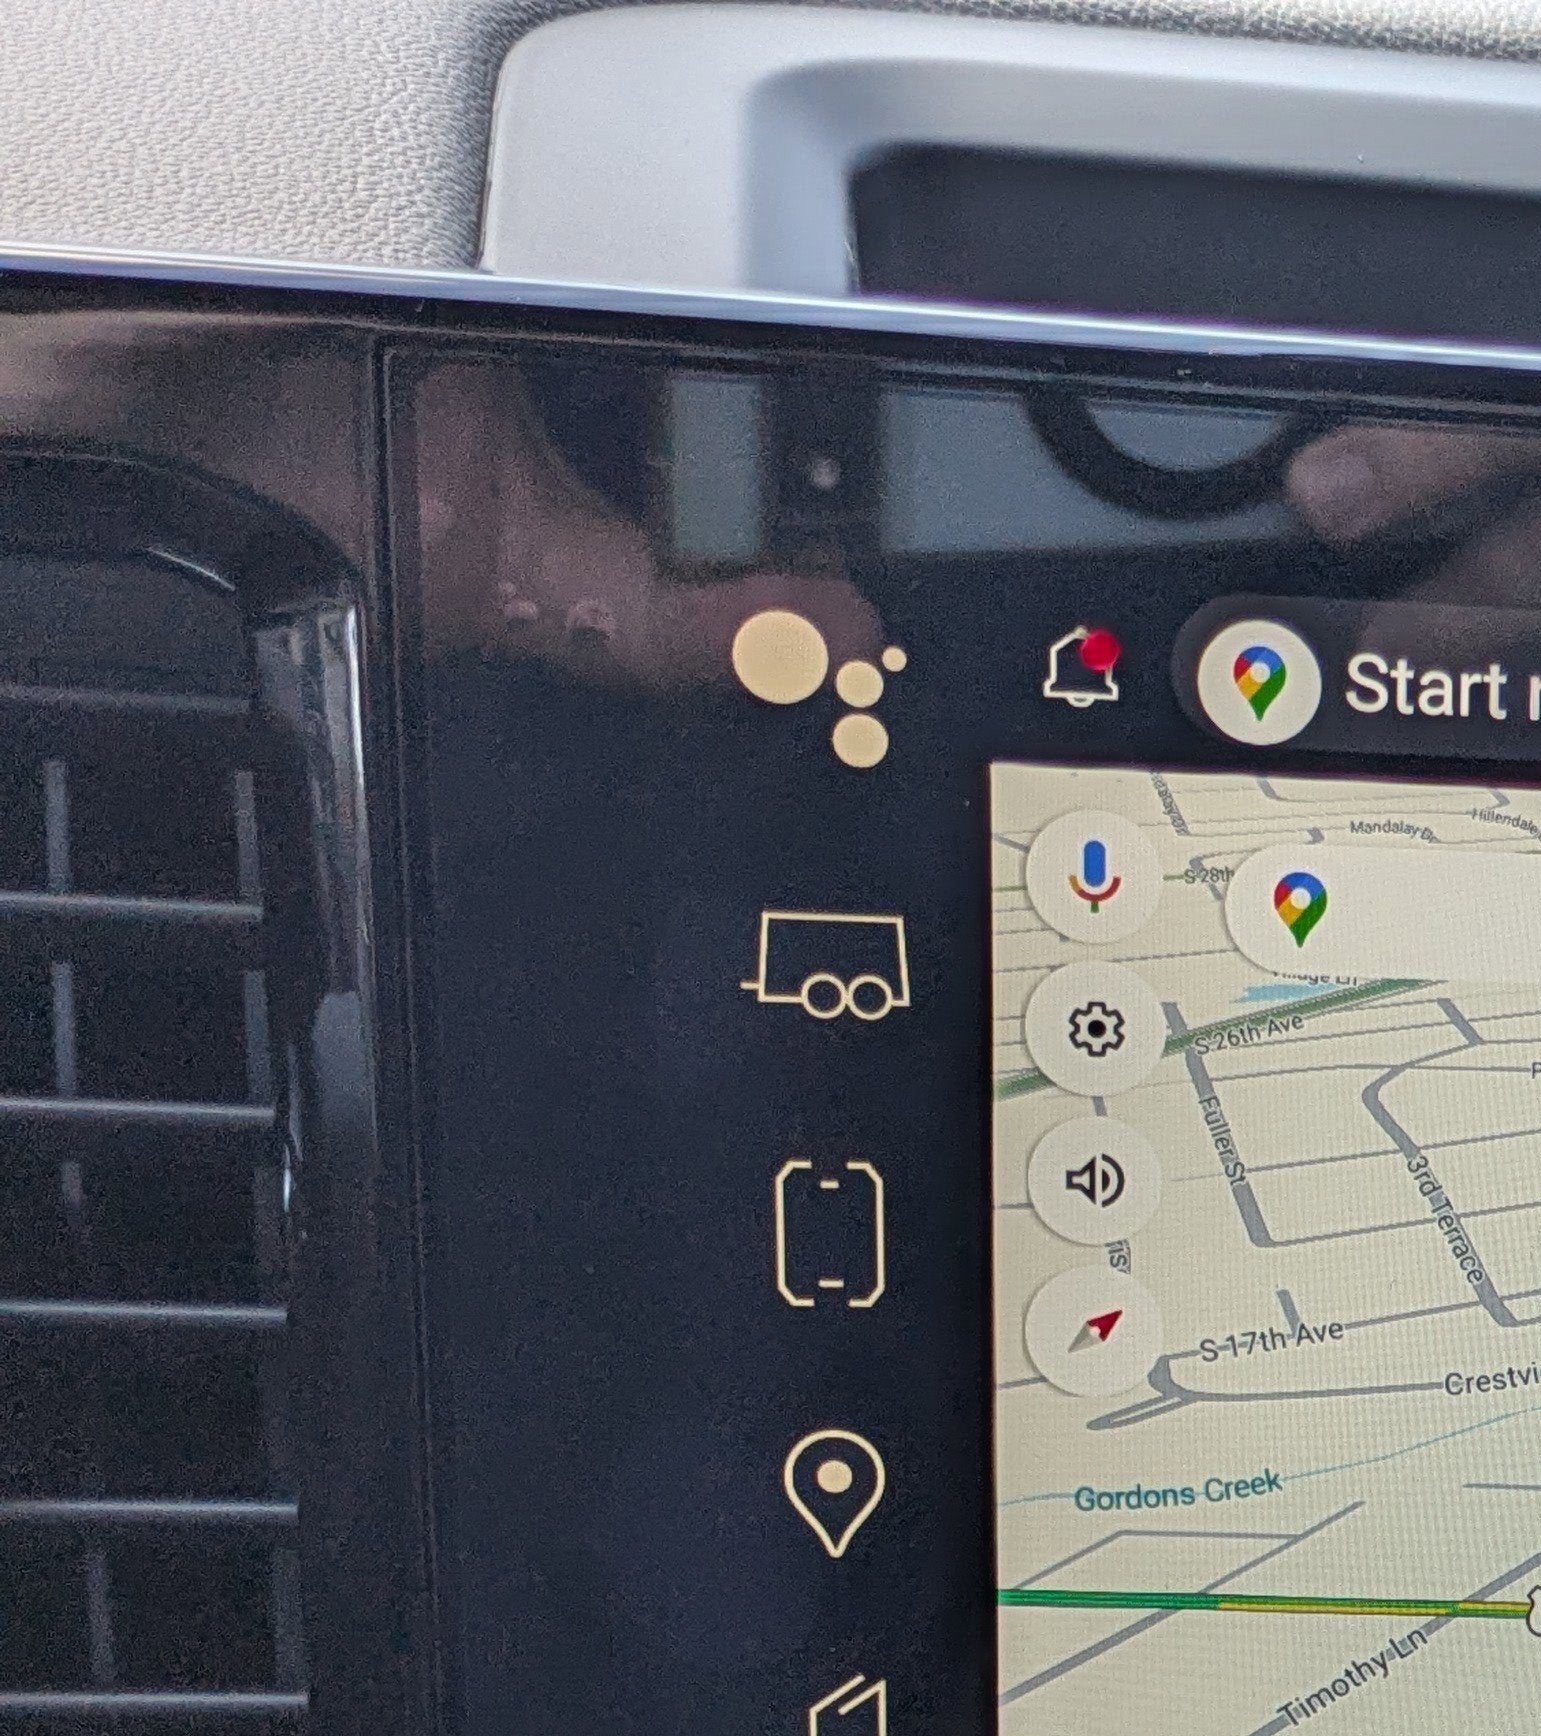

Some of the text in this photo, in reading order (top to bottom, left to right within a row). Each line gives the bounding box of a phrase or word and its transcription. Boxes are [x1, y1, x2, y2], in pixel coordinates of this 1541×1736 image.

[1345, 652, 1508, 722] Start
[1350, 820, 1440, 843] Mandalay Dr
[1194, 1013, 1305, 1055] S 26th Ave
[1199, 1095, 1247, 1186] Fuller St
[1407, 1153, 1483, 1285] 3rd Terrace
[1200, 1320, 1344, 1362] S 17th Ave
[1074, 1468, 1283, 1513] Gordons Creek
[1276, 1627, 1428, 1727] Timothy Ln
